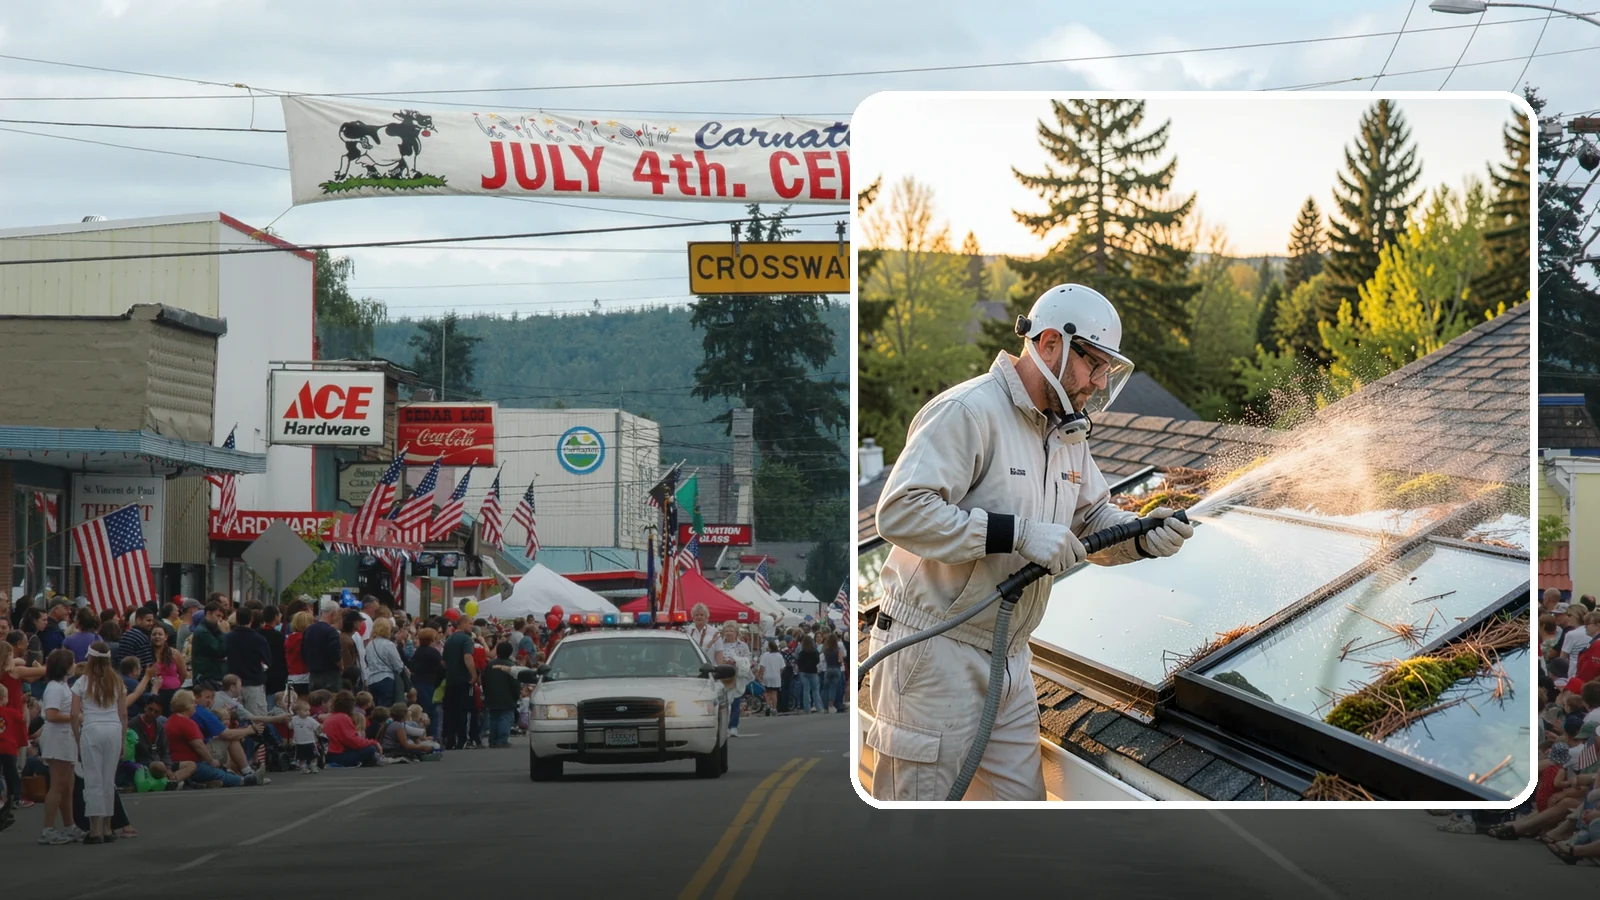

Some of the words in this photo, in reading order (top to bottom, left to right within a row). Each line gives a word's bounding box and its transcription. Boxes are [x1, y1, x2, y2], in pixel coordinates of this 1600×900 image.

[695, 121, 850, 150] Carnat
[481, 140, 605, 193] JULY
[632, 150, 746, 198] 4th.
[697, 253, 850, 280] CROSSWA
[283, 380, 373, 420] ACE
[405, 409, 452, 422] CEDAR
[461, 409, 485, 422] LOG
[283, 421, 370, 436] Hardware
[416, 428, 477, 447] Coca-Cola
[96, 485, 124, 495] Vincent
[126, 486, 135, 495] de
[138, 486, 155, 495] Paul
[688, 526, 741, 535] CRNATION
[699, 535, 730, 543] GLASS
